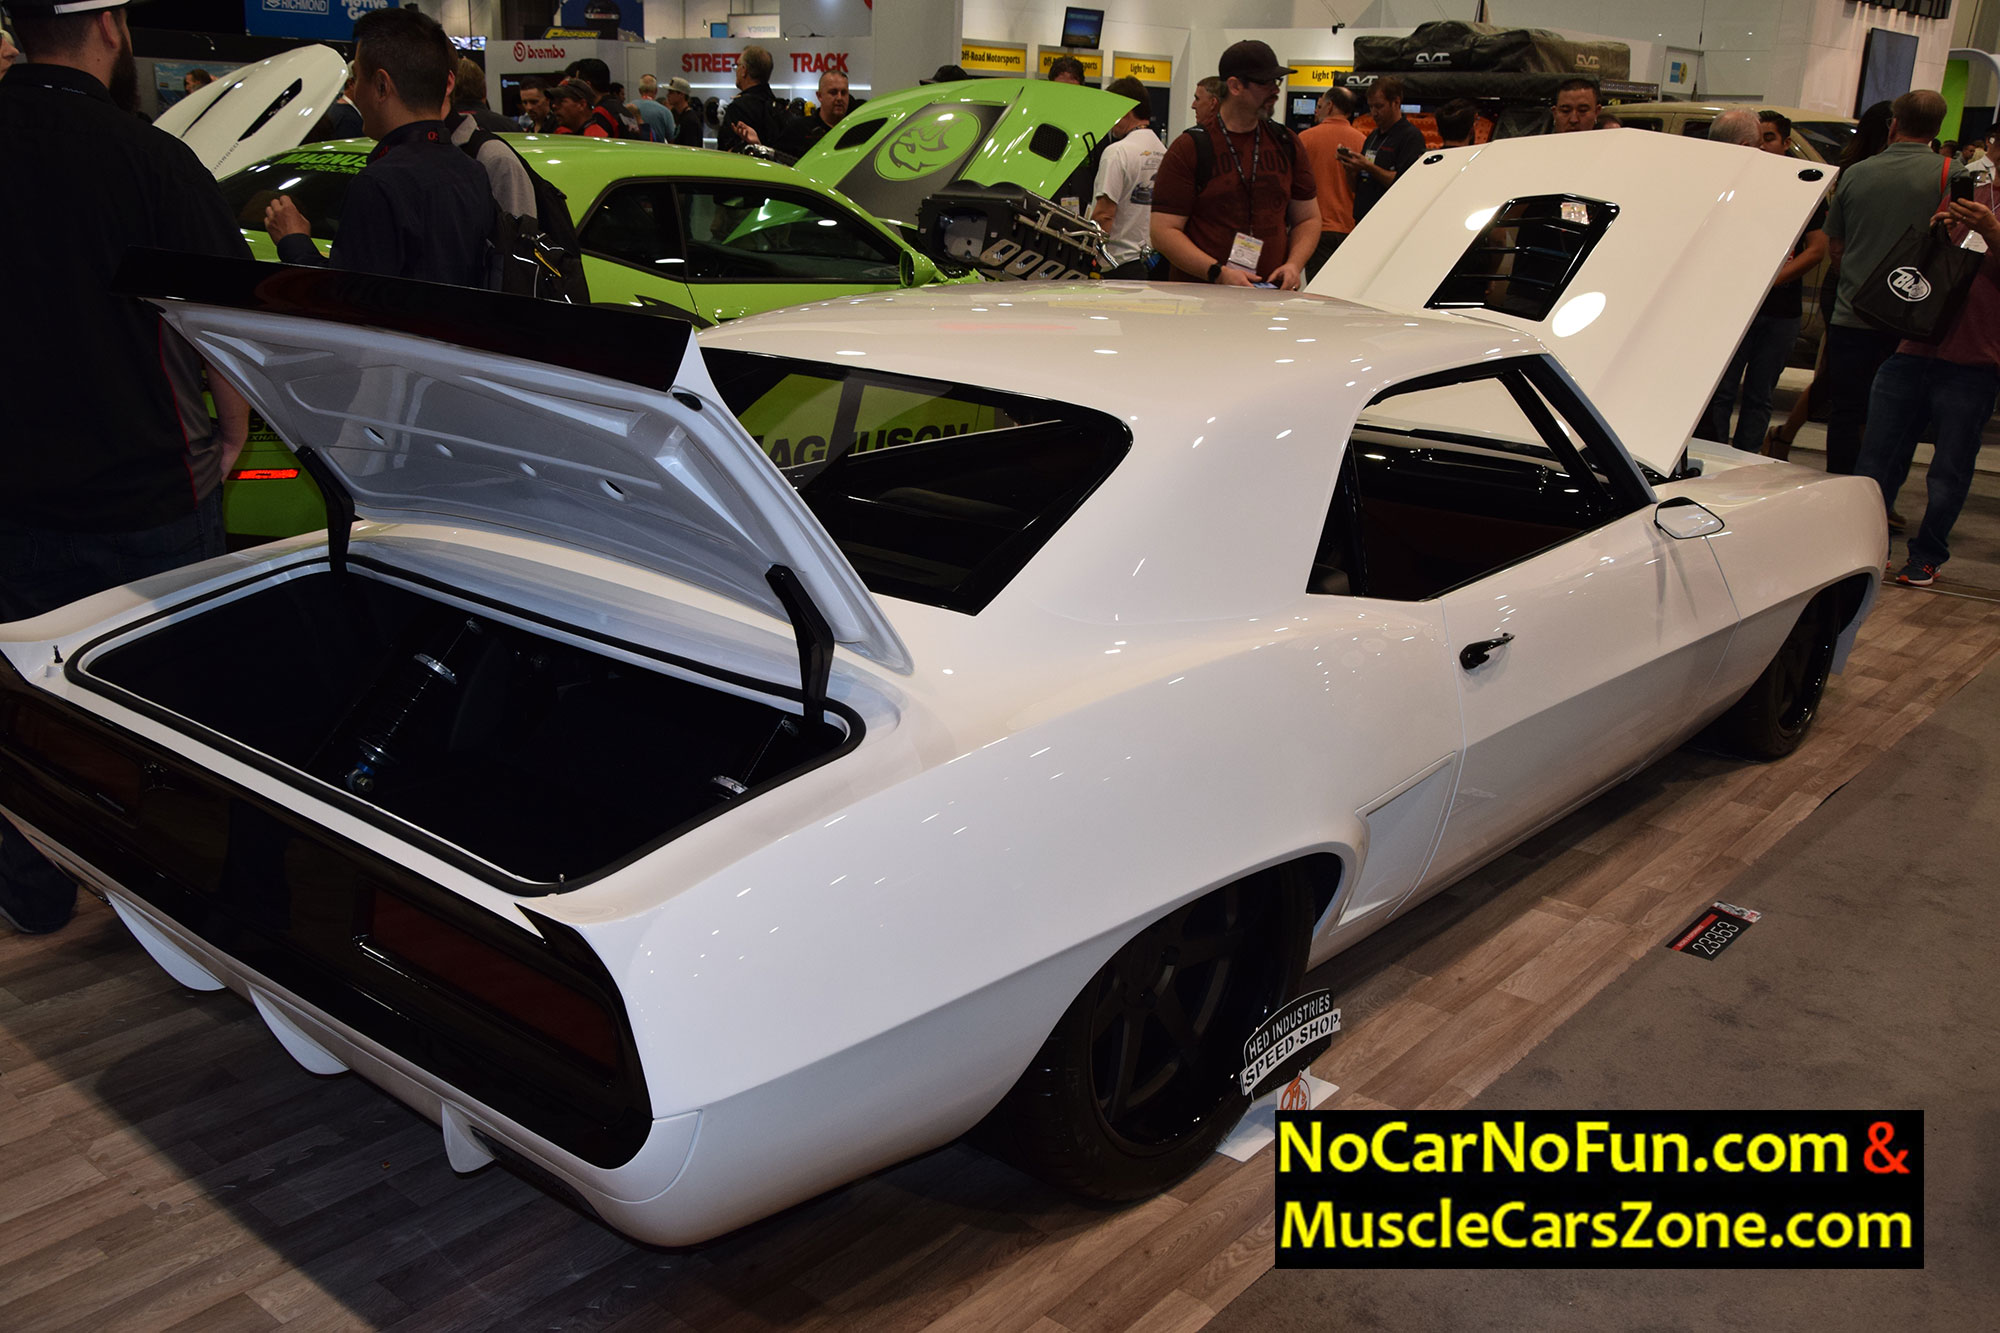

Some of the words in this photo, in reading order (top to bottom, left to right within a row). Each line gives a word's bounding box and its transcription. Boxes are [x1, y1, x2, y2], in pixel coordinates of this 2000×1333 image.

[527, 45, 566, 59] brembo
[986, 53, 1021, 66] Motorsports
[789, 53, 849, 73] TRACK
[1312, 70, 1329, 82] Light
[1692, 921, 1739, 955] 23353
[1248, 1030, 1270, 1060] HED
[1272, 993, 1331, 1041] INDUSTRIES
